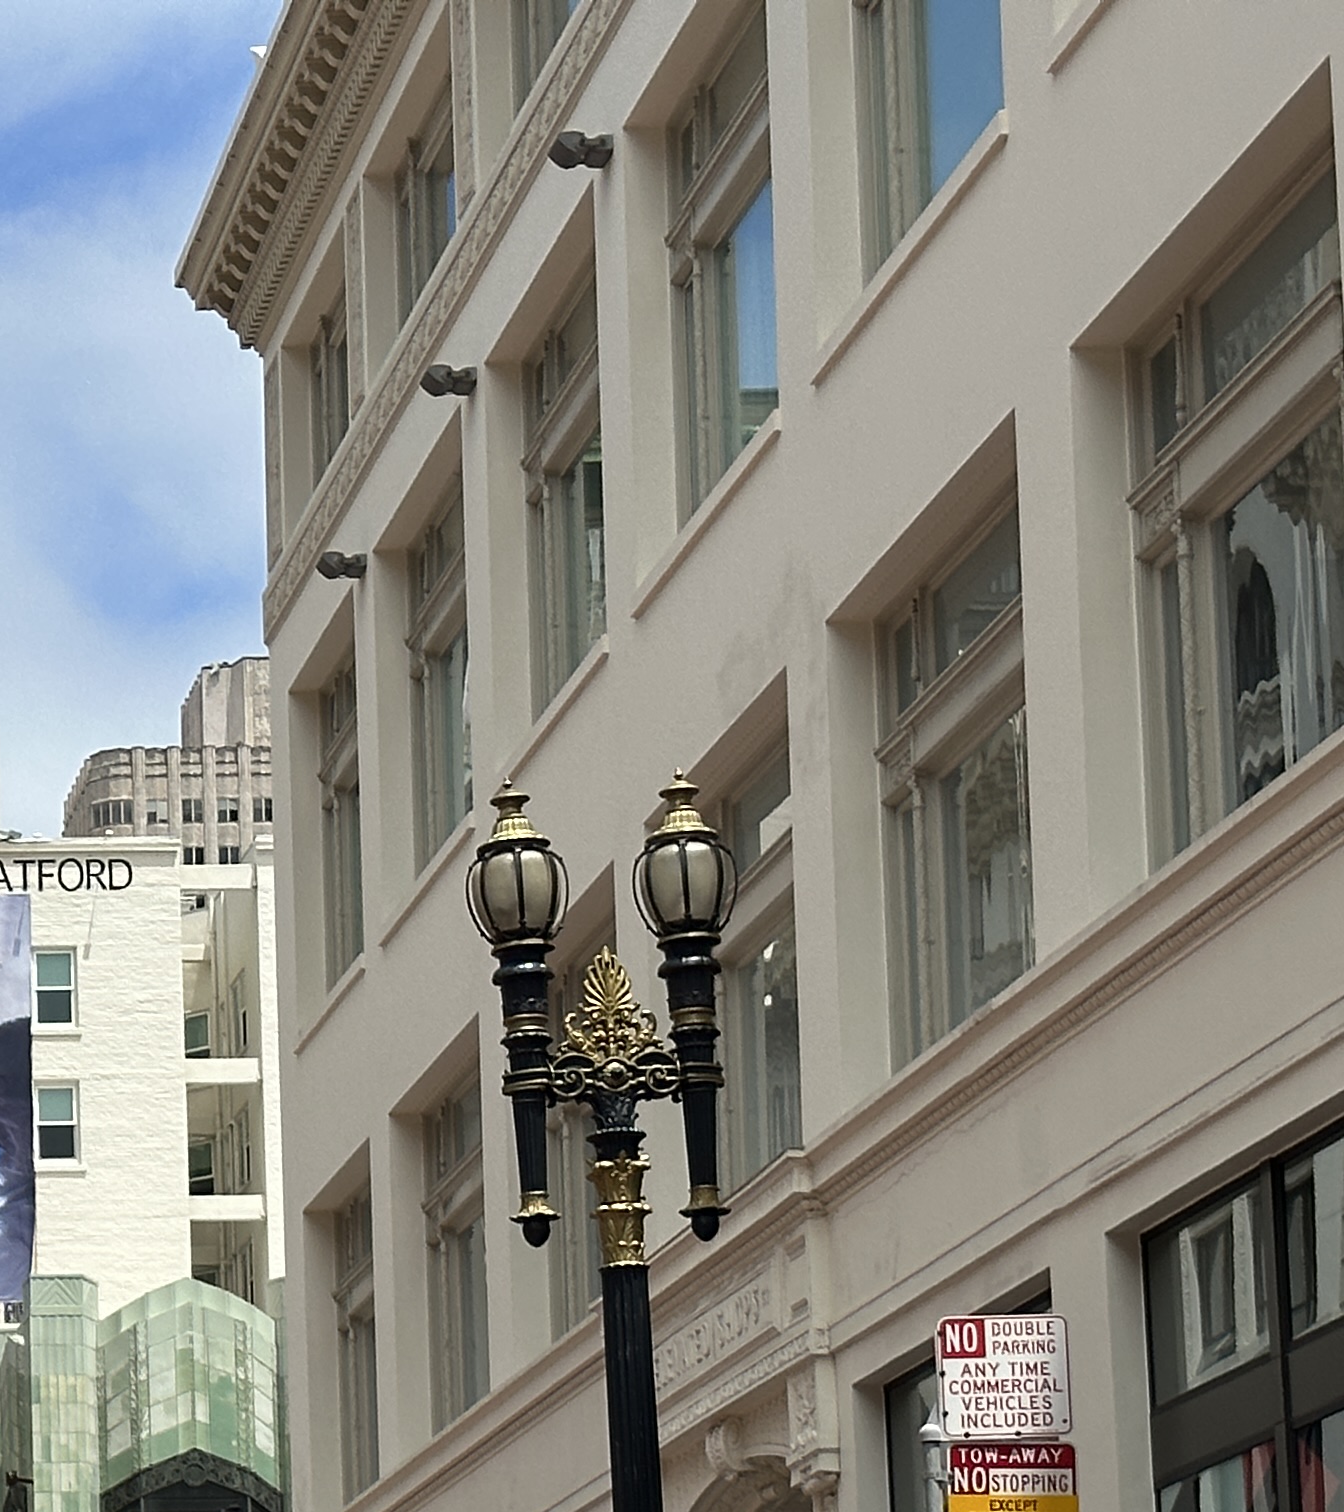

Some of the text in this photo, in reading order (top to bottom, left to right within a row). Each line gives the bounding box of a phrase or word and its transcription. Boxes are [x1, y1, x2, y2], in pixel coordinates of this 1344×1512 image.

[945, 1320, 1055, 1353] NO DOUBLE
[992, 1339, 1056, 1355] PARKING
[961, 1361, 1051, 1377] ANY TIME
[949, 1378, 1063, 1395] COMMERCIAL
[961, 1395, 1052, 1412] VEHICLES
[961, 1412, 1054, 1429] INCLUDED
[958, 1447, 1062, 1464] TOW-AWAY
[953, 1466, 1069, 1493] NO STOPPING
[989, 1499, 1038, 1512] EXCEPT
